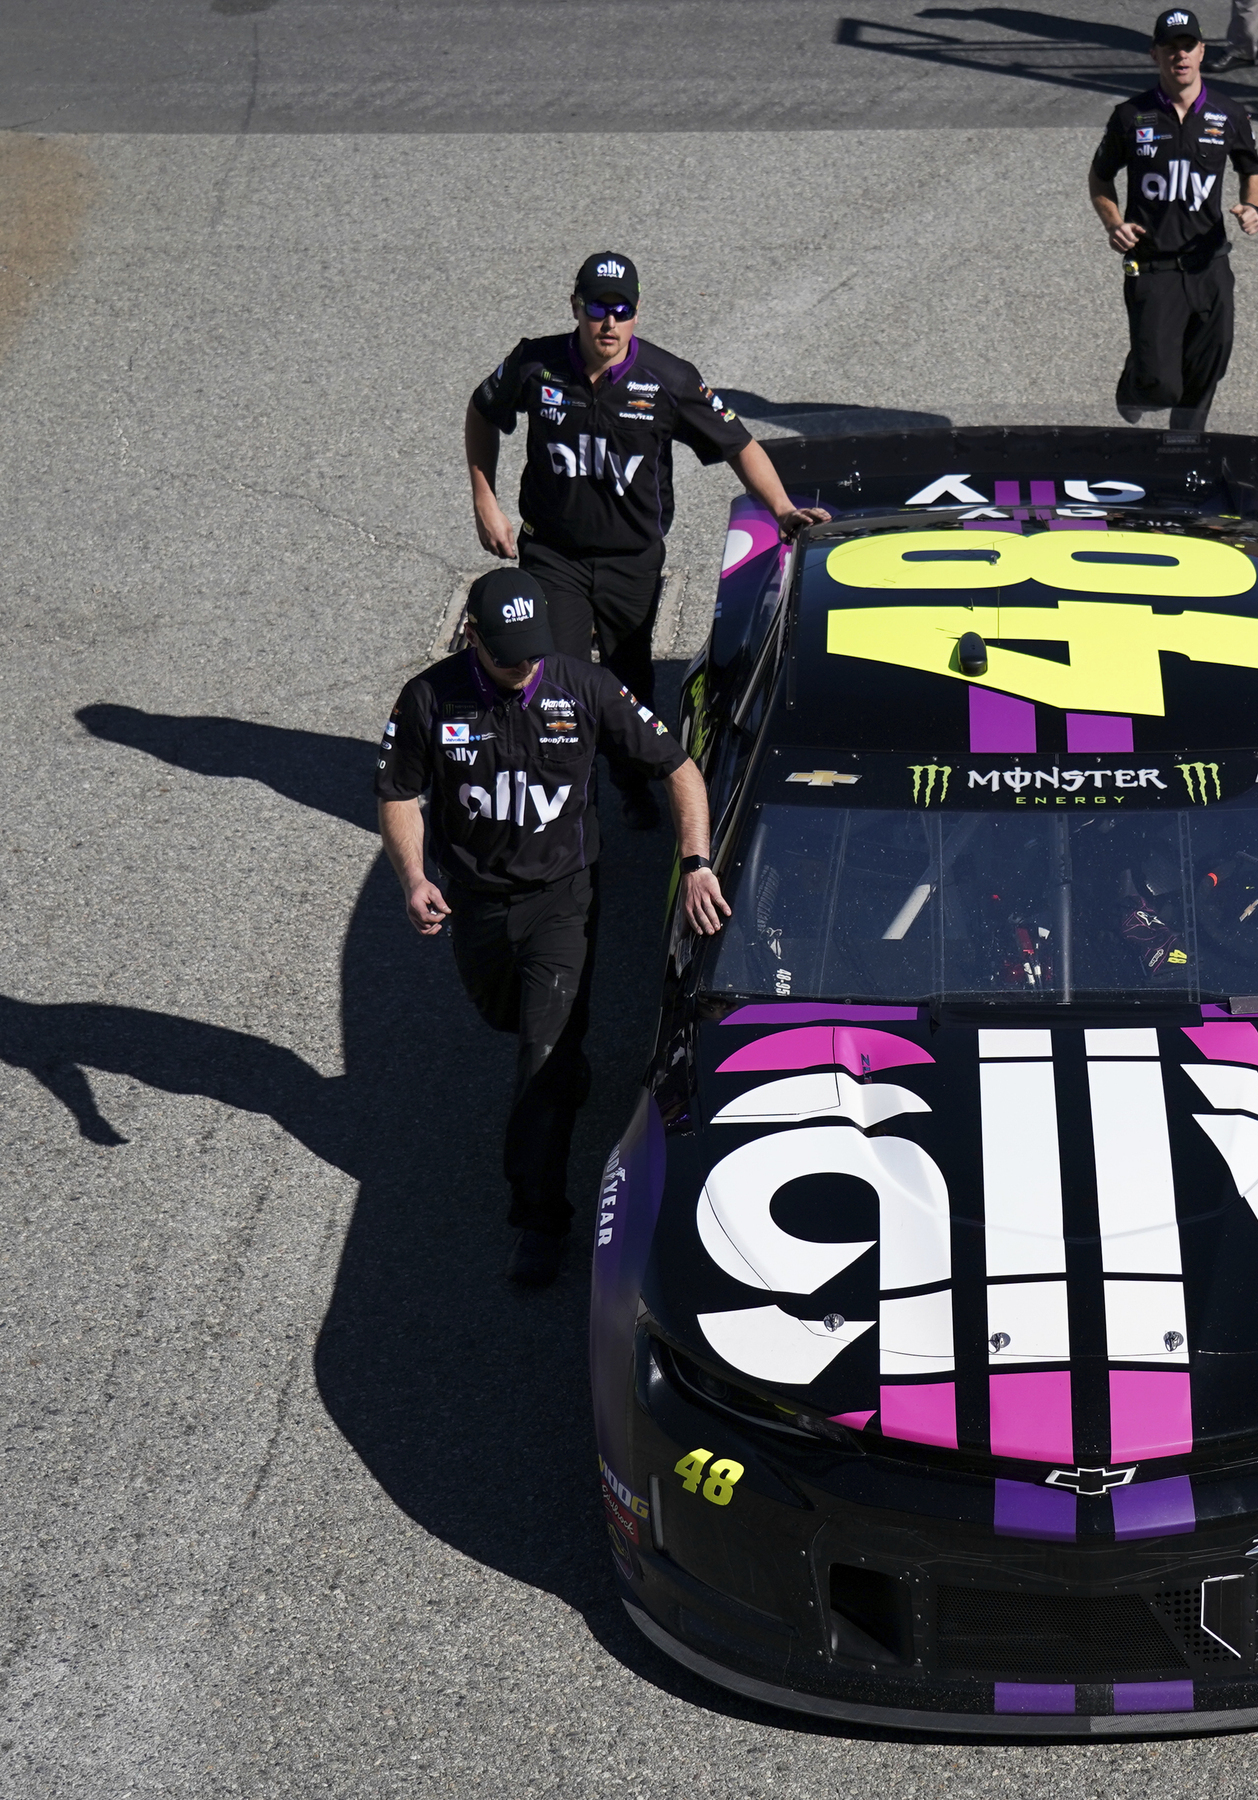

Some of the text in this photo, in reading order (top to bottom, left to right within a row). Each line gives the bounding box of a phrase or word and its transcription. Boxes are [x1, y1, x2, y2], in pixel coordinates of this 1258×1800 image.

[1166, 11, 1189, 25] ally
[1136, 144, 1158, 159] ally
[1141, 159, 1217, 212] ally
[597, 260, 626, 279] ally
[540, 407, 567, 426] ally
[546, 433, 645, 497] ally
[502, 597, 534, 619] ally
[445, 747, 478, 766] ally
[967, 765, 1169, 793] MONSTER
[459, 770, 573, 834] ally
[1016, 796, 1125, 805] ENERGY
[1167, 949, 1188, 965] 48
[597, 1140, 626, 1248] OODYEAR
[673, 1447, 745, 1507] 48
